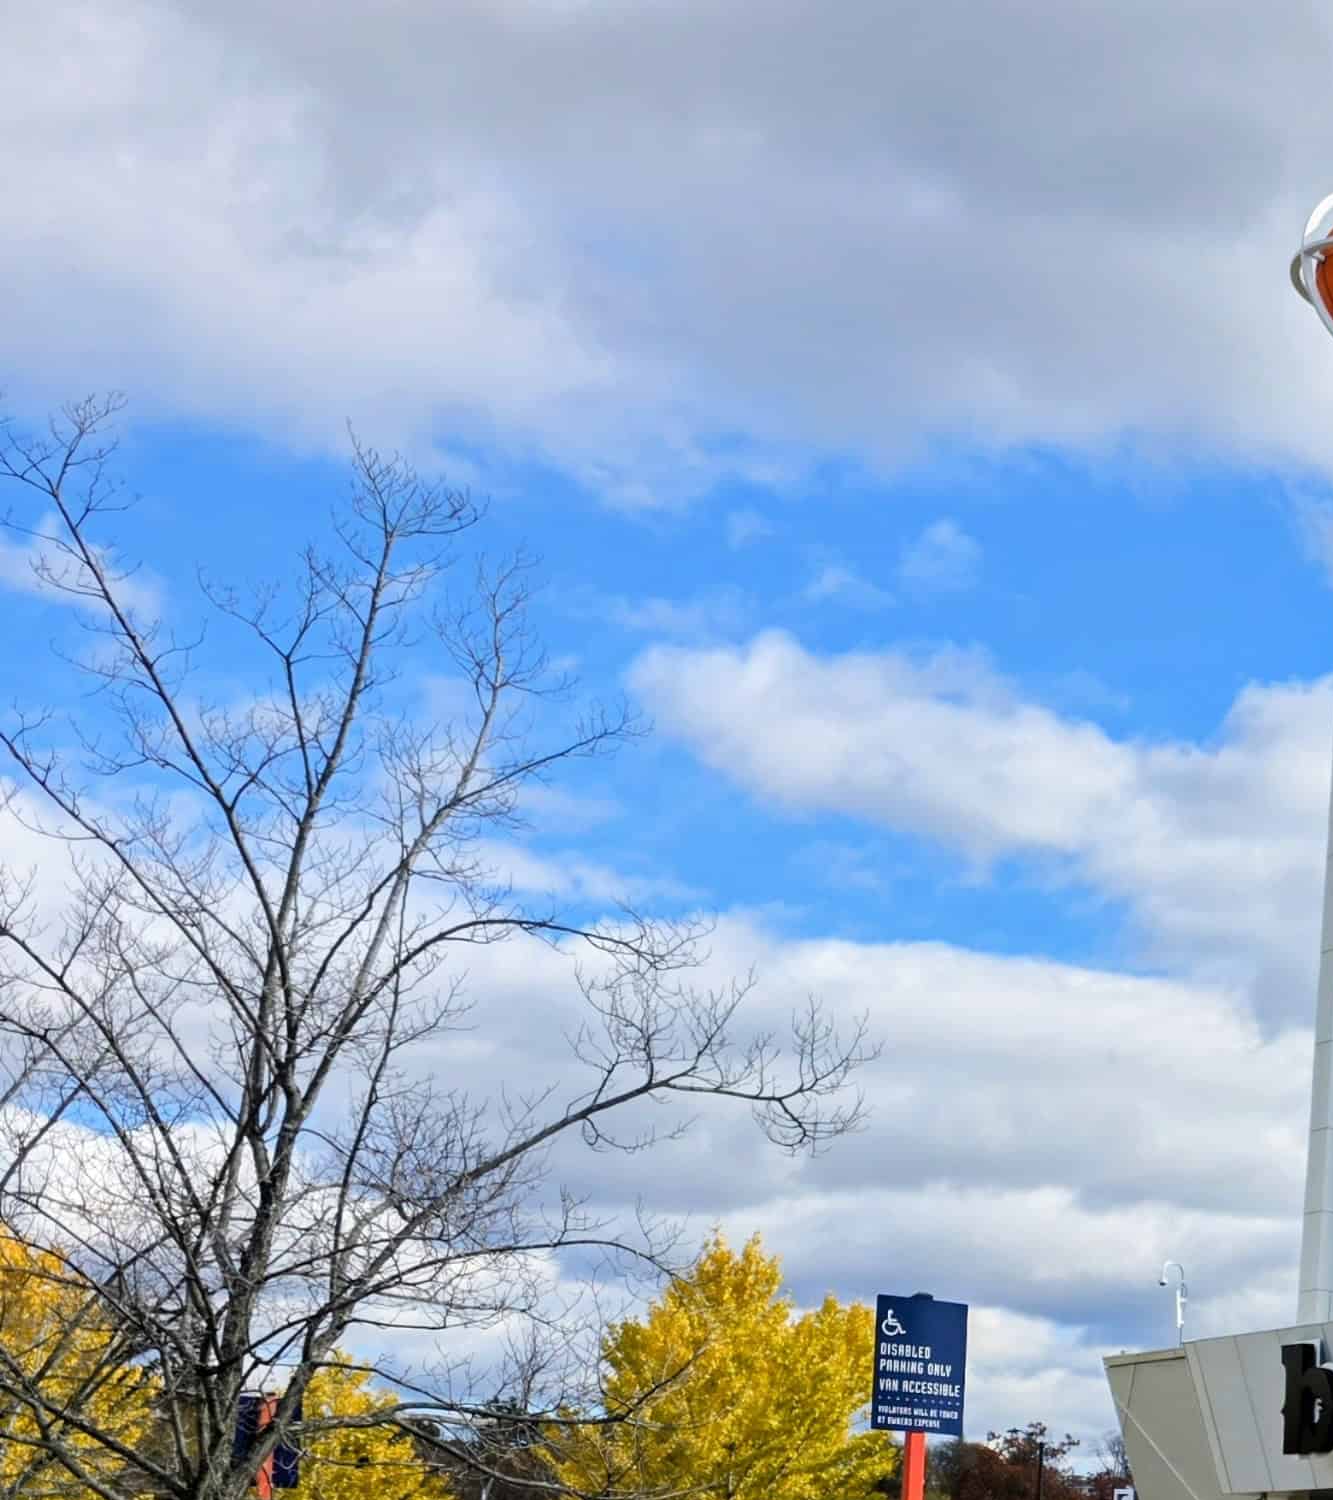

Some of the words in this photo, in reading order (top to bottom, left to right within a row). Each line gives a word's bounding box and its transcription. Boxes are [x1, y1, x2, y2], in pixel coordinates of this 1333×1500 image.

[880, 1342, 931, 1359] DISABLED
[879, 1358, 925, 1375] PARKING
[927, 1362, 952, 1377] ONLY
[879, 1378, 899, 1393] VAN
[902, 1379, 961, 1397] ACCESSIBLE
